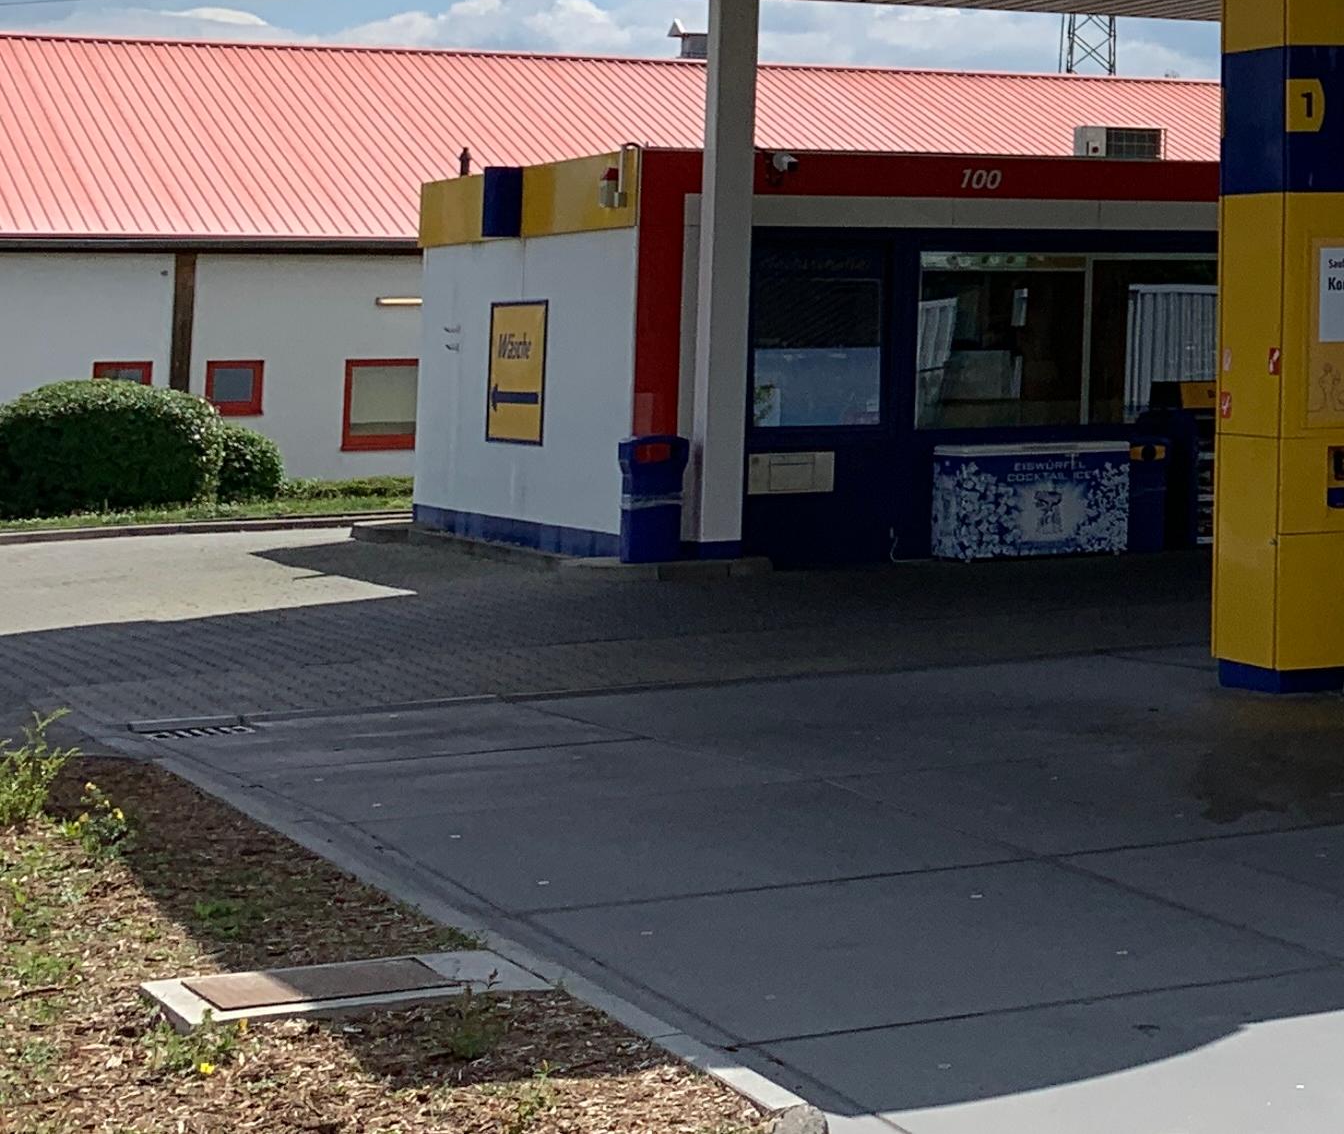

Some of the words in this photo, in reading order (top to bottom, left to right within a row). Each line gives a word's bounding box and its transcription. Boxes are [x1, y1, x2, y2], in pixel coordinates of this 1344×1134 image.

[1301, 92, 1313, 118] 1
[961, 168, 1002, 190] 100
[1006, 472, 1068, 483] COCKTAIL
[1073, 470, 1092, 480] ICE
